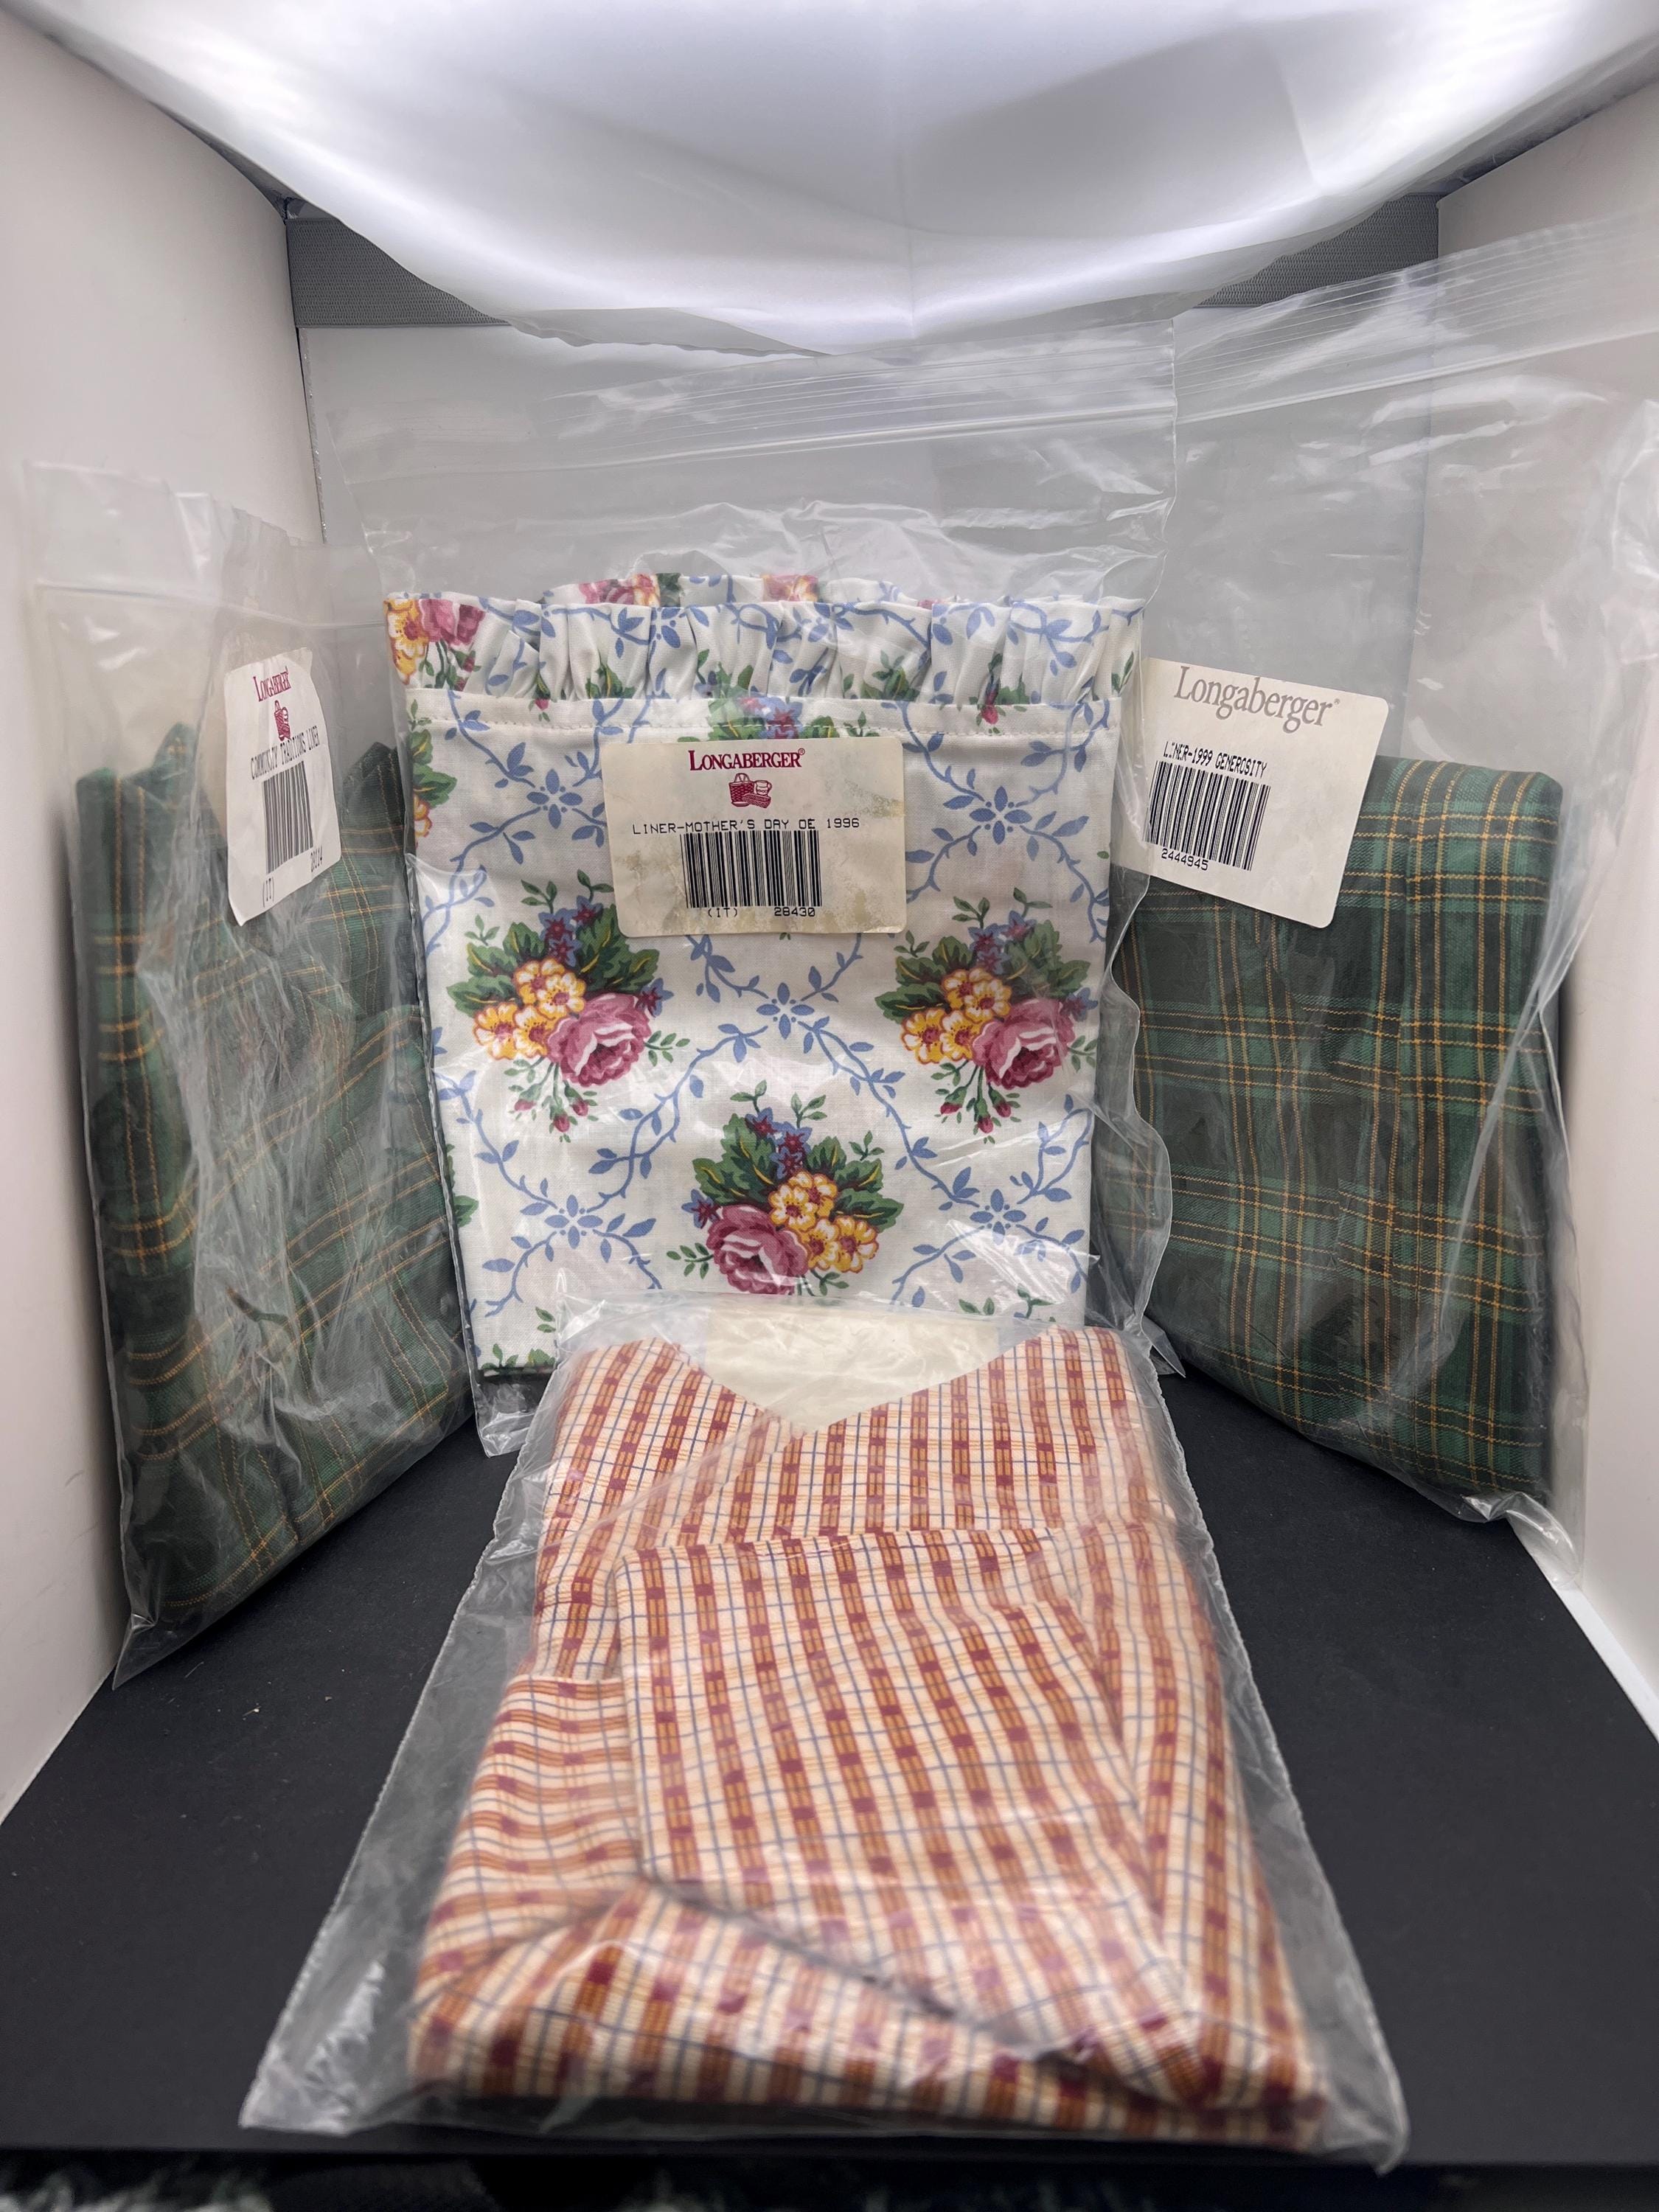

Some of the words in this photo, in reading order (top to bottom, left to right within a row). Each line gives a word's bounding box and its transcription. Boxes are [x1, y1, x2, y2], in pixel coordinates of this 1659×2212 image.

[306, 725, 320, 751] LINER
[1163, 740, 1214, 768] LINER-1999
[1215, 752, 1268, 779] GENEROSITY
[632, 819, 756, 835] LINER-MOTHER'S
[764, 818, 790, 830] DAY
[827, 817, 860, 829] 1996
[1161, 848, 1209, 872] 2444945
[708, 908, 738, 918] (IT)
[773, 906, 816, 917] 28430
